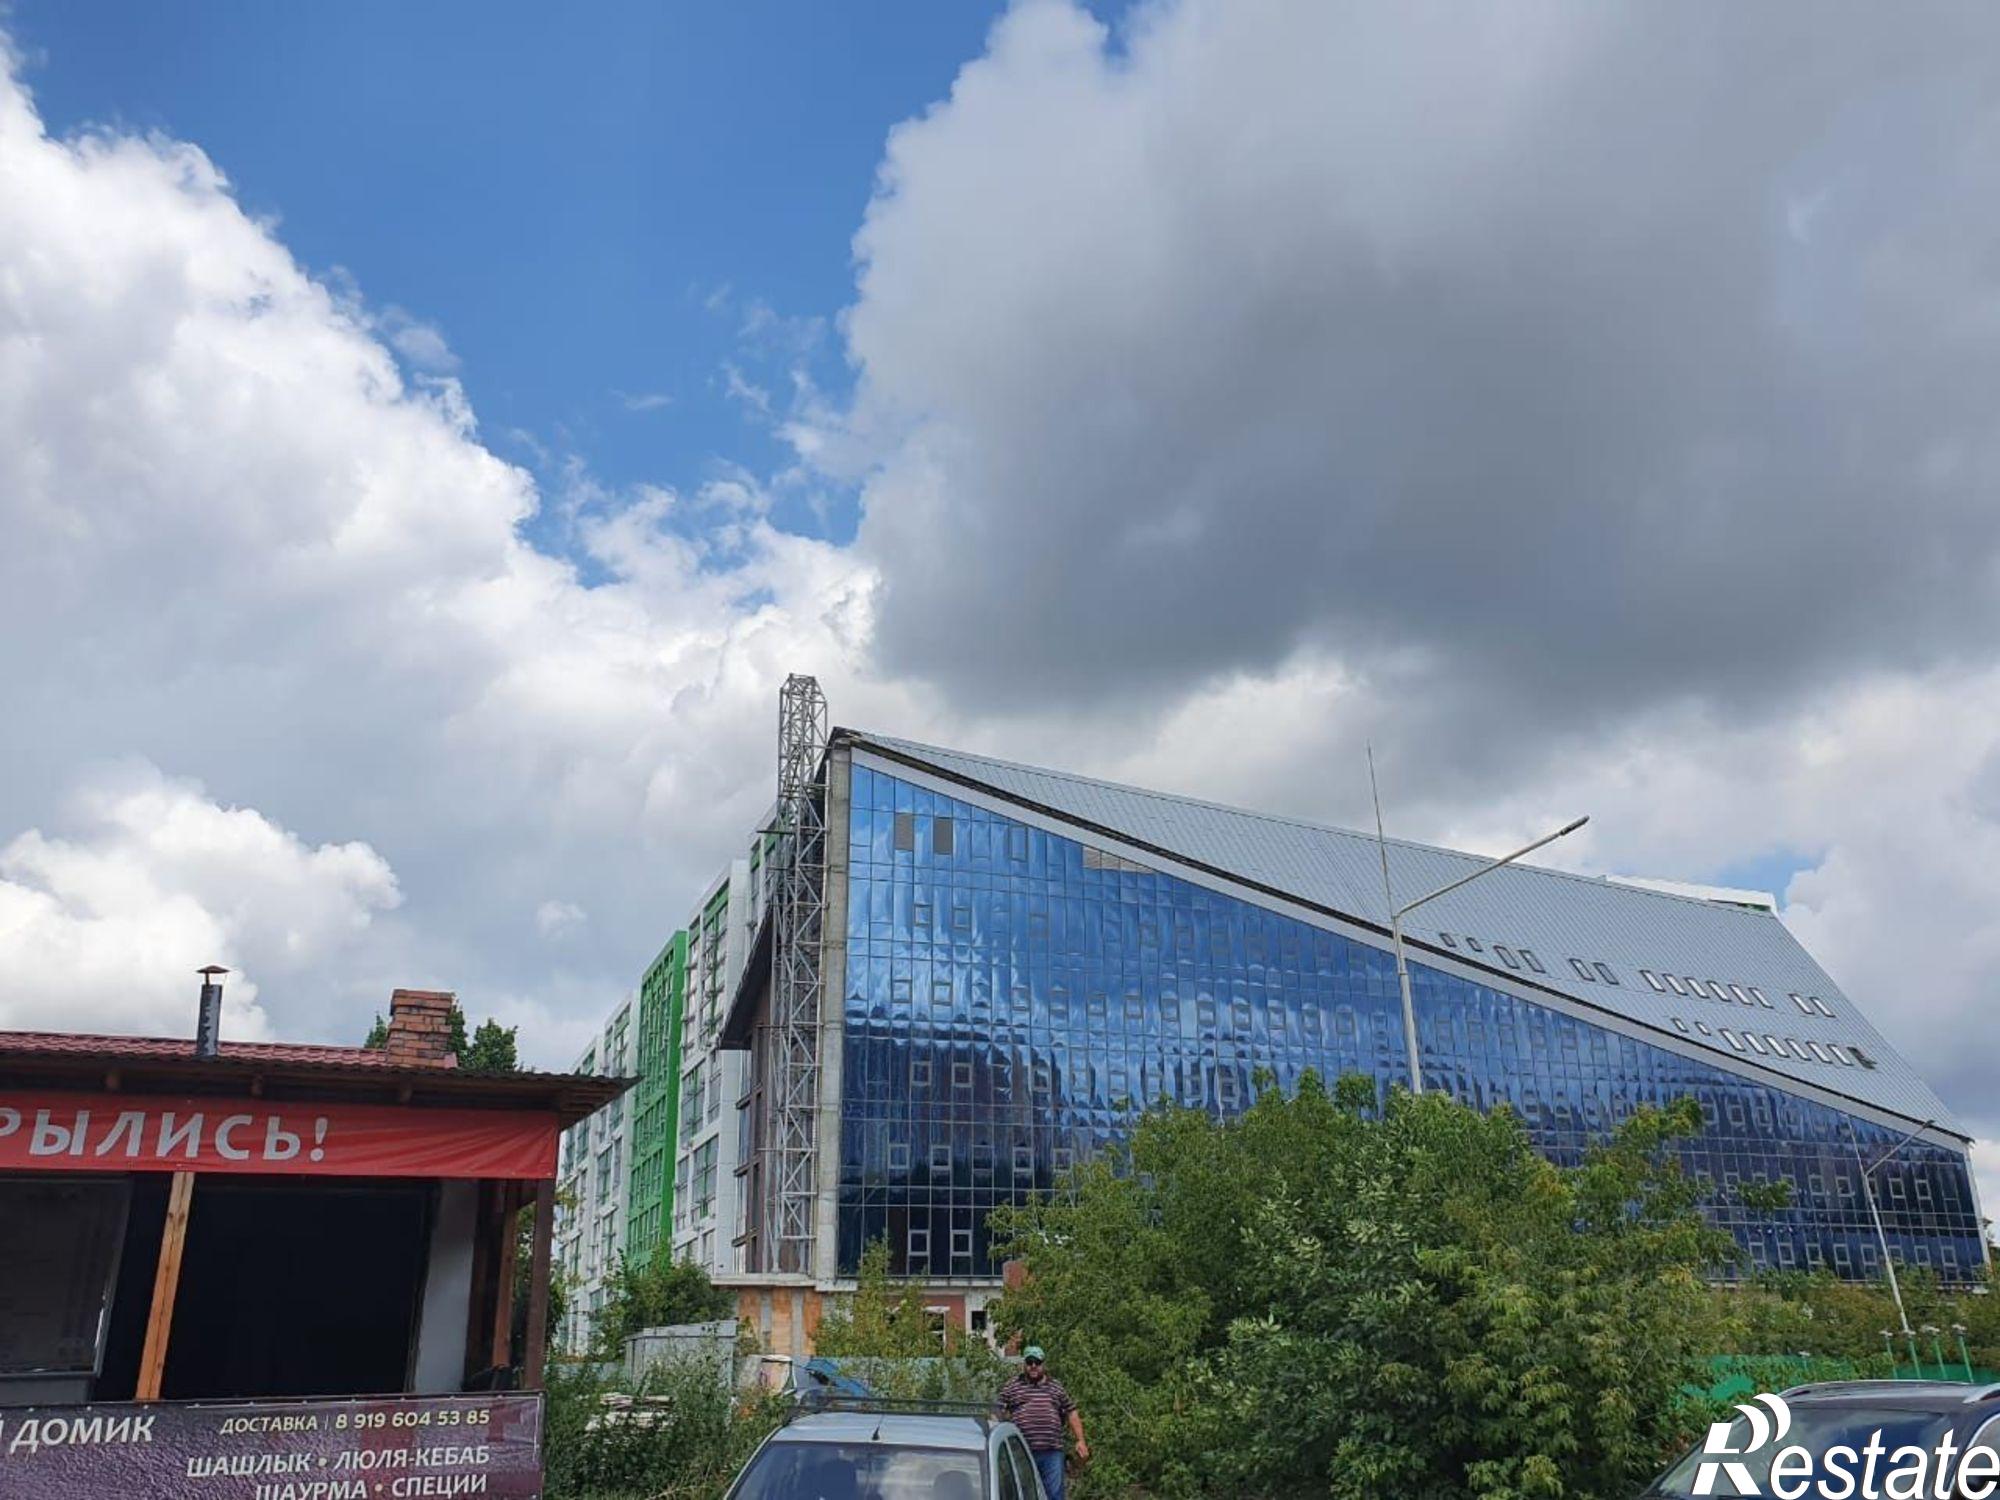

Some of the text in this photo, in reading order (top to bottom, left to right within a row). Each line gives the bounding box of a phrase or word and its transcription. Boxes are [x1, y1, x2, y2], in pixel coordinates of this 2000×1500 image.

[10, 1415, 156, 1454] ДОМИК
[220, 1409, 491, 1435] ДОСТАВКА 8 919 604 53 85
[186, 1445, 490, 1478] ШАШЛЫК ЛЮЛЯ-КЕБАБ
[391, 1474, 488, 1499] СПЕЦИИ
